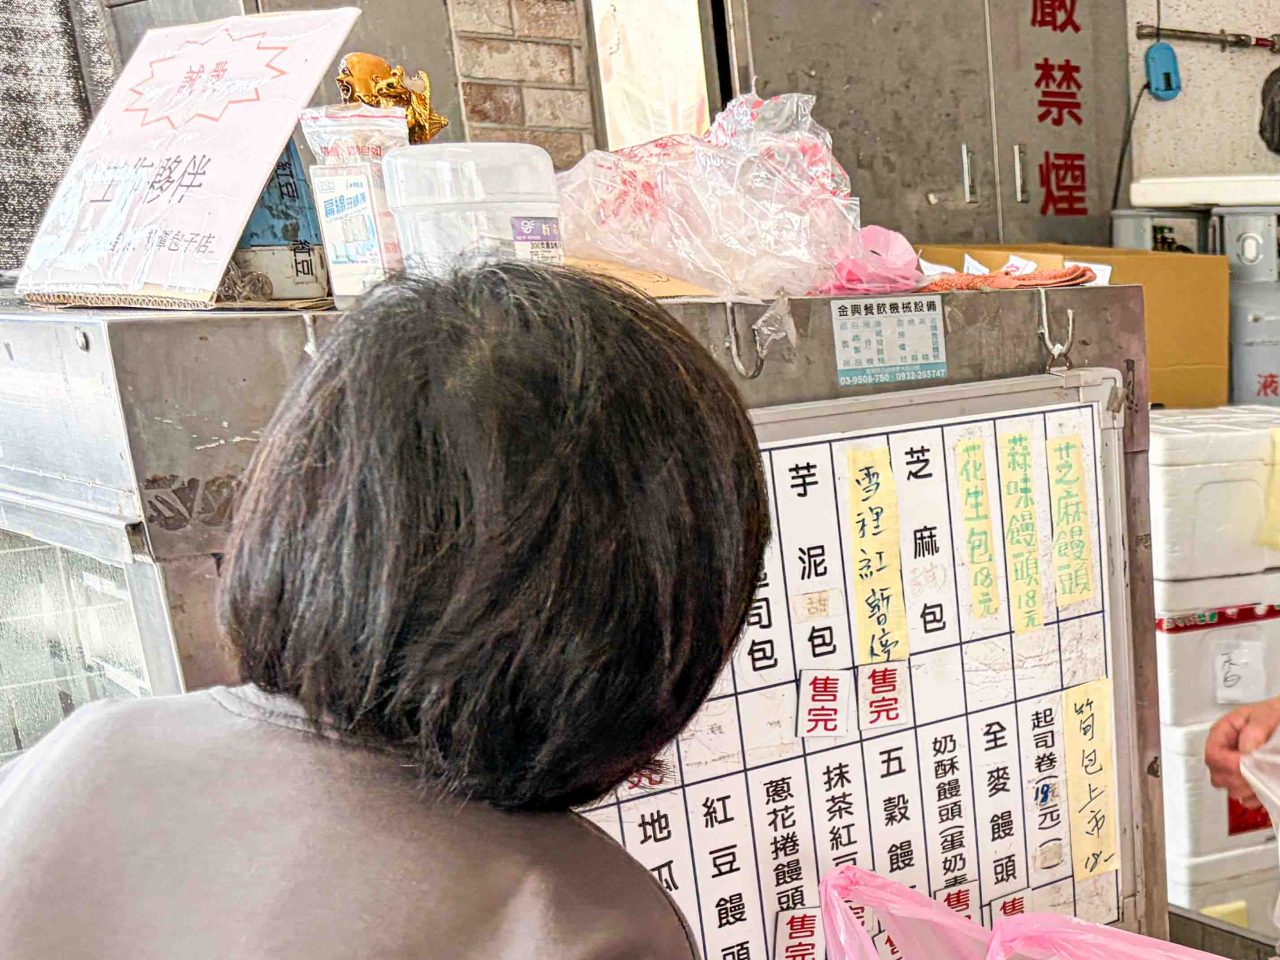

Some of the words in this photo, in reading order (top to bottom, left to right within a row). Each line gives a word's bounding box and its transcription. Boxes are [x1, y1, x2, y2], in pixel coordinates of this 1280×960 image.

[292, 240, 315, 277] 紅豆
[837, 300, 937, 317] 金興餐飲機械設備
[788, 462, 837, 658] 芋泥包
[904, 445, 947, 634] 芝麻包
[747, 568, 779, 673] 司包
[806, 675, 840, 733] 售完
[868, 667, 900, 724] 售完
[878, 746, 916, 889] 五穀饅
[982, 721, 1018, 886] 全麥饅頭
